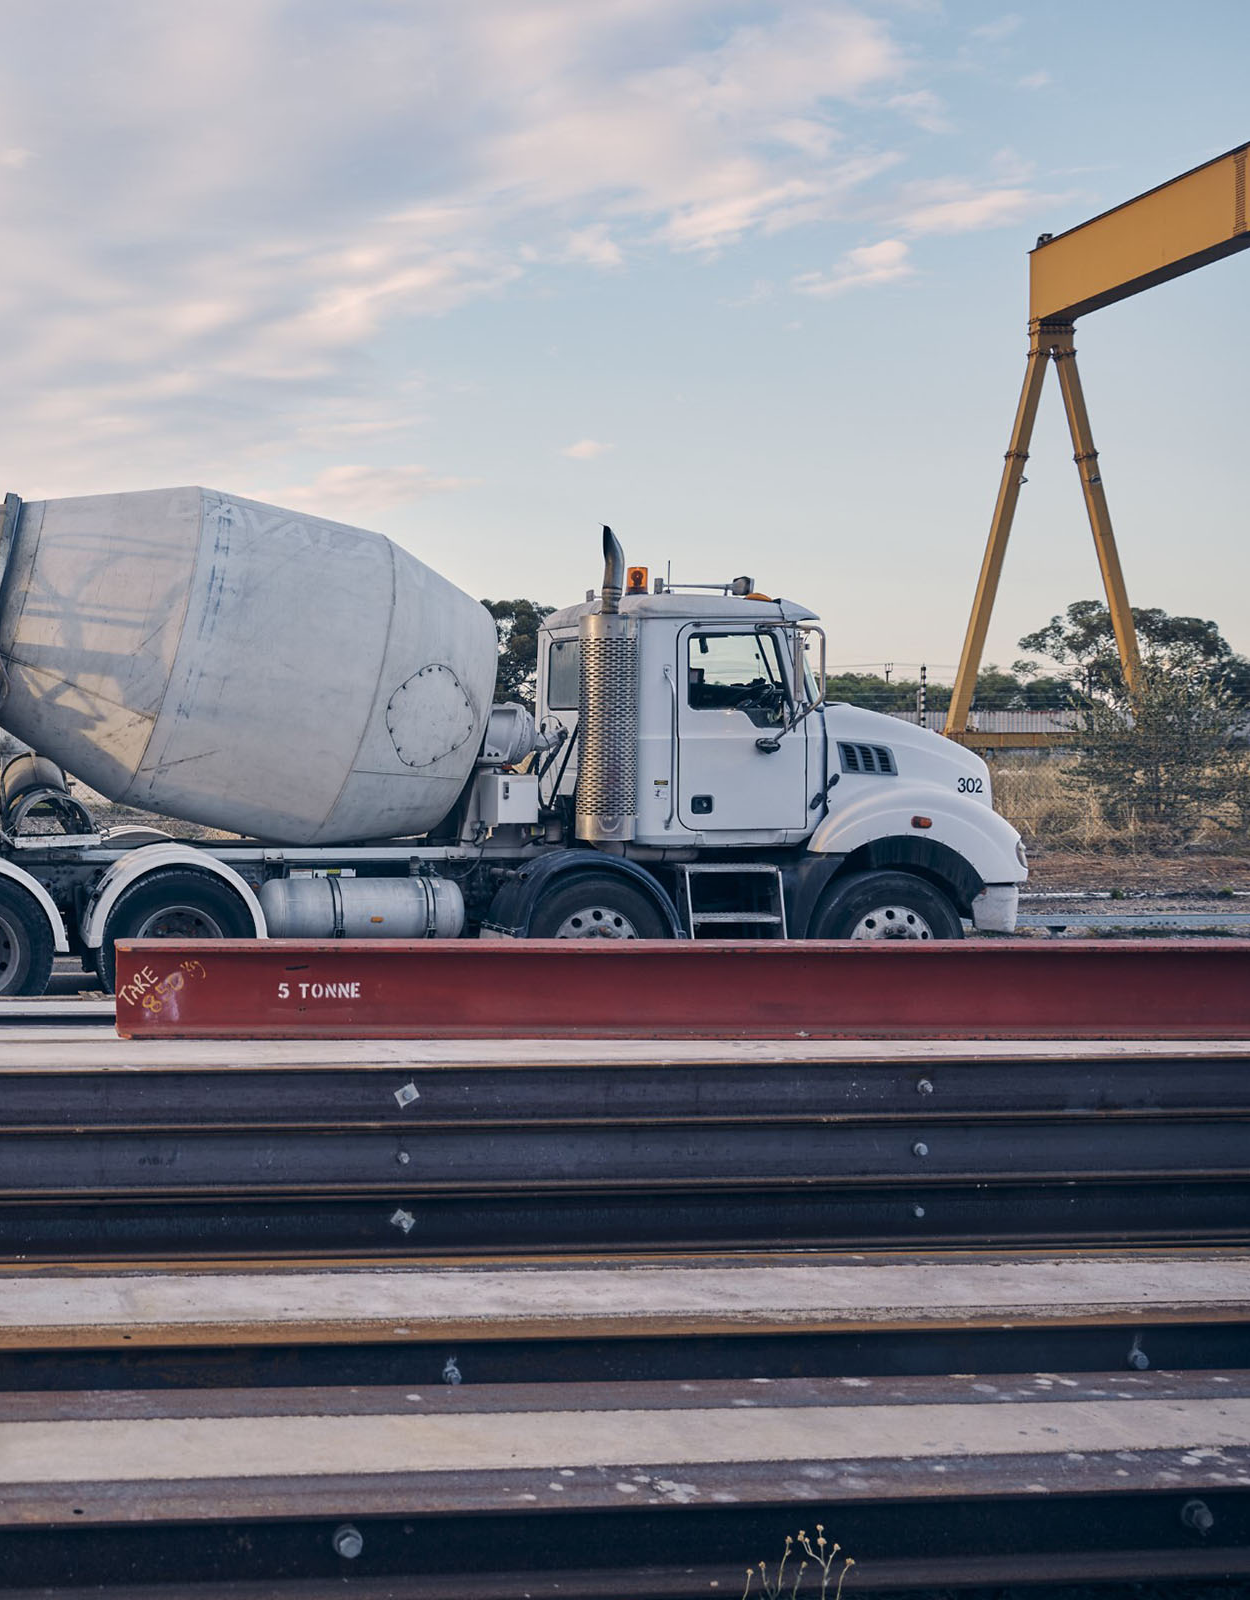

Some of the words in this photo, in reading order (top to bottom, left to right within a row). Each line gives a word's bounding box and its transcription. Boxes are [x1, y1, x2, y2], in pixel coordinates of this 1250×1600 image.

[957, 777, 983, 793] 302
[278, 982, 290, 999] 5
[298, 982, 361, 999] TONNE
